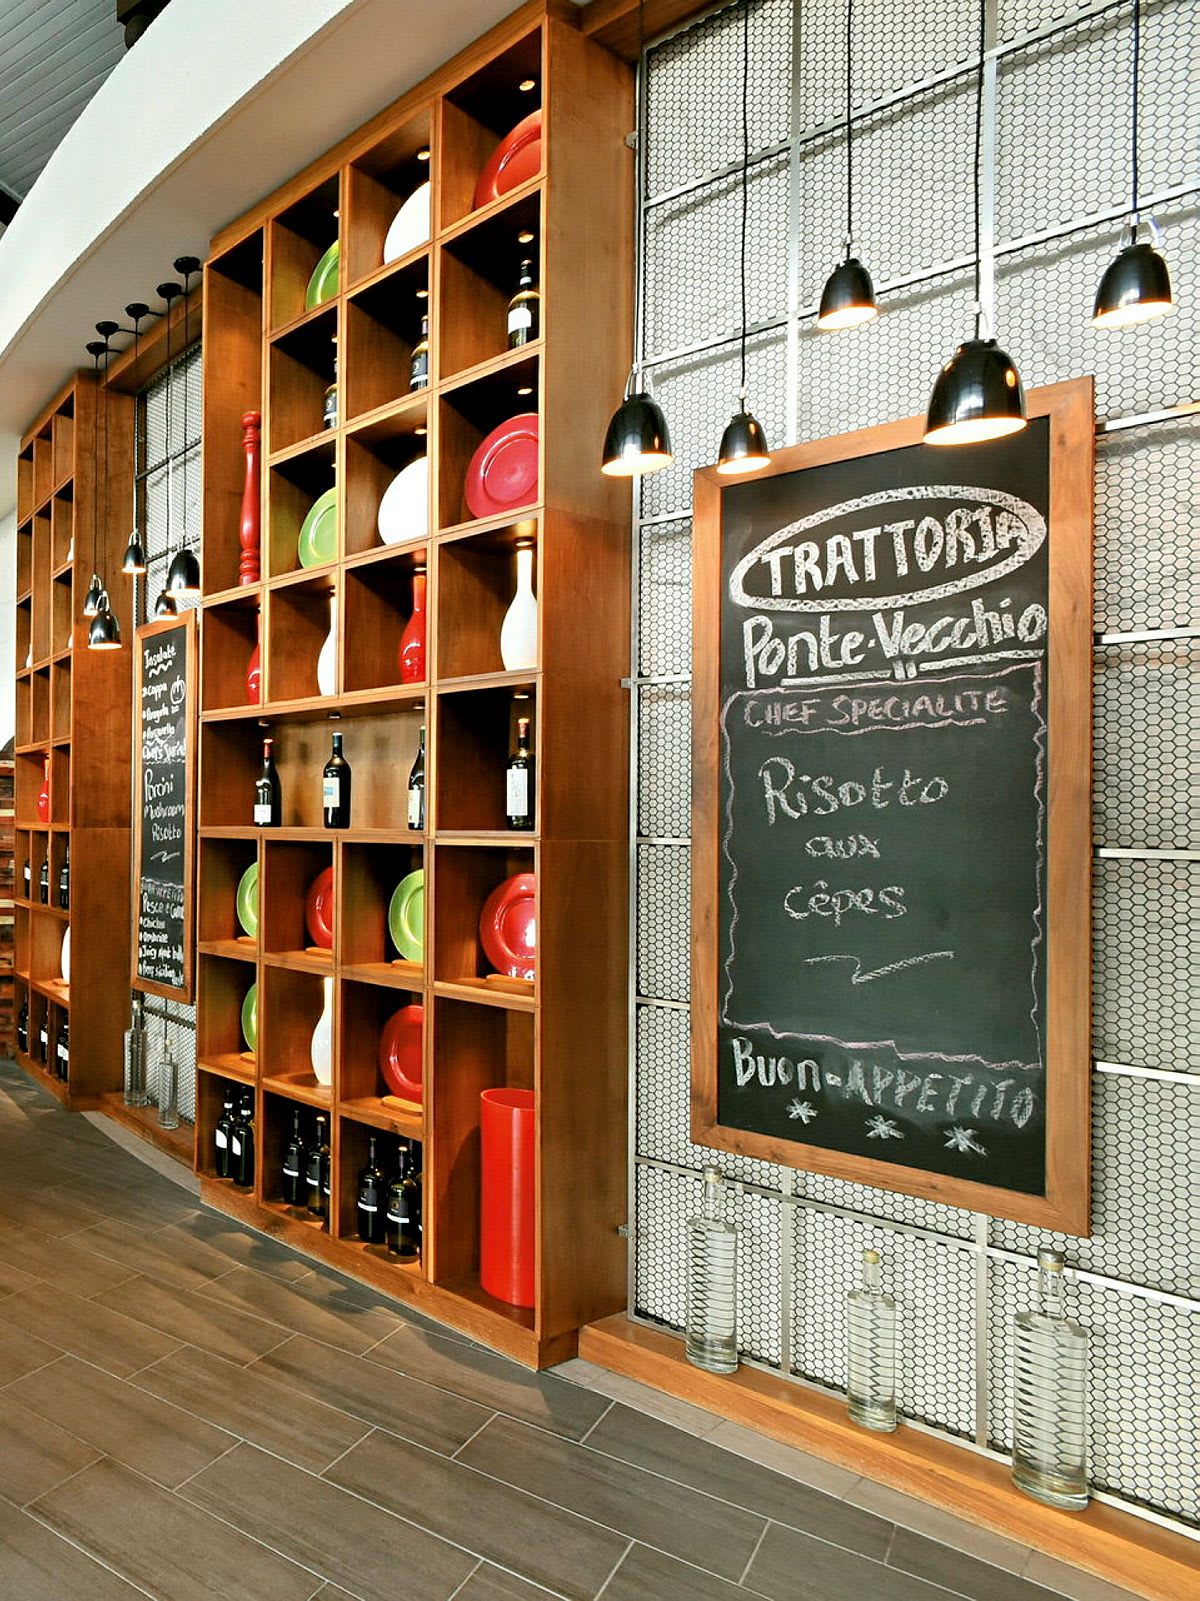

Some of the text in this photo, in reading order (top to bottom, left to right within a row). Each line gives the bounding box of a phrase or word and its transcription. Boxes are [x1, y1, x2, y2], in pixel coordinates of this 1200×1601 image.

[761, 504, 1030, 596] TRATTORIA
[744, 697, 822, 726] CHEF
[144, 768, 174, 802] Porcini
[758, 756, 950, 826] Risotto
[152, 823, 182, 841] Risotto
[805, 834, 882, 859] aux
